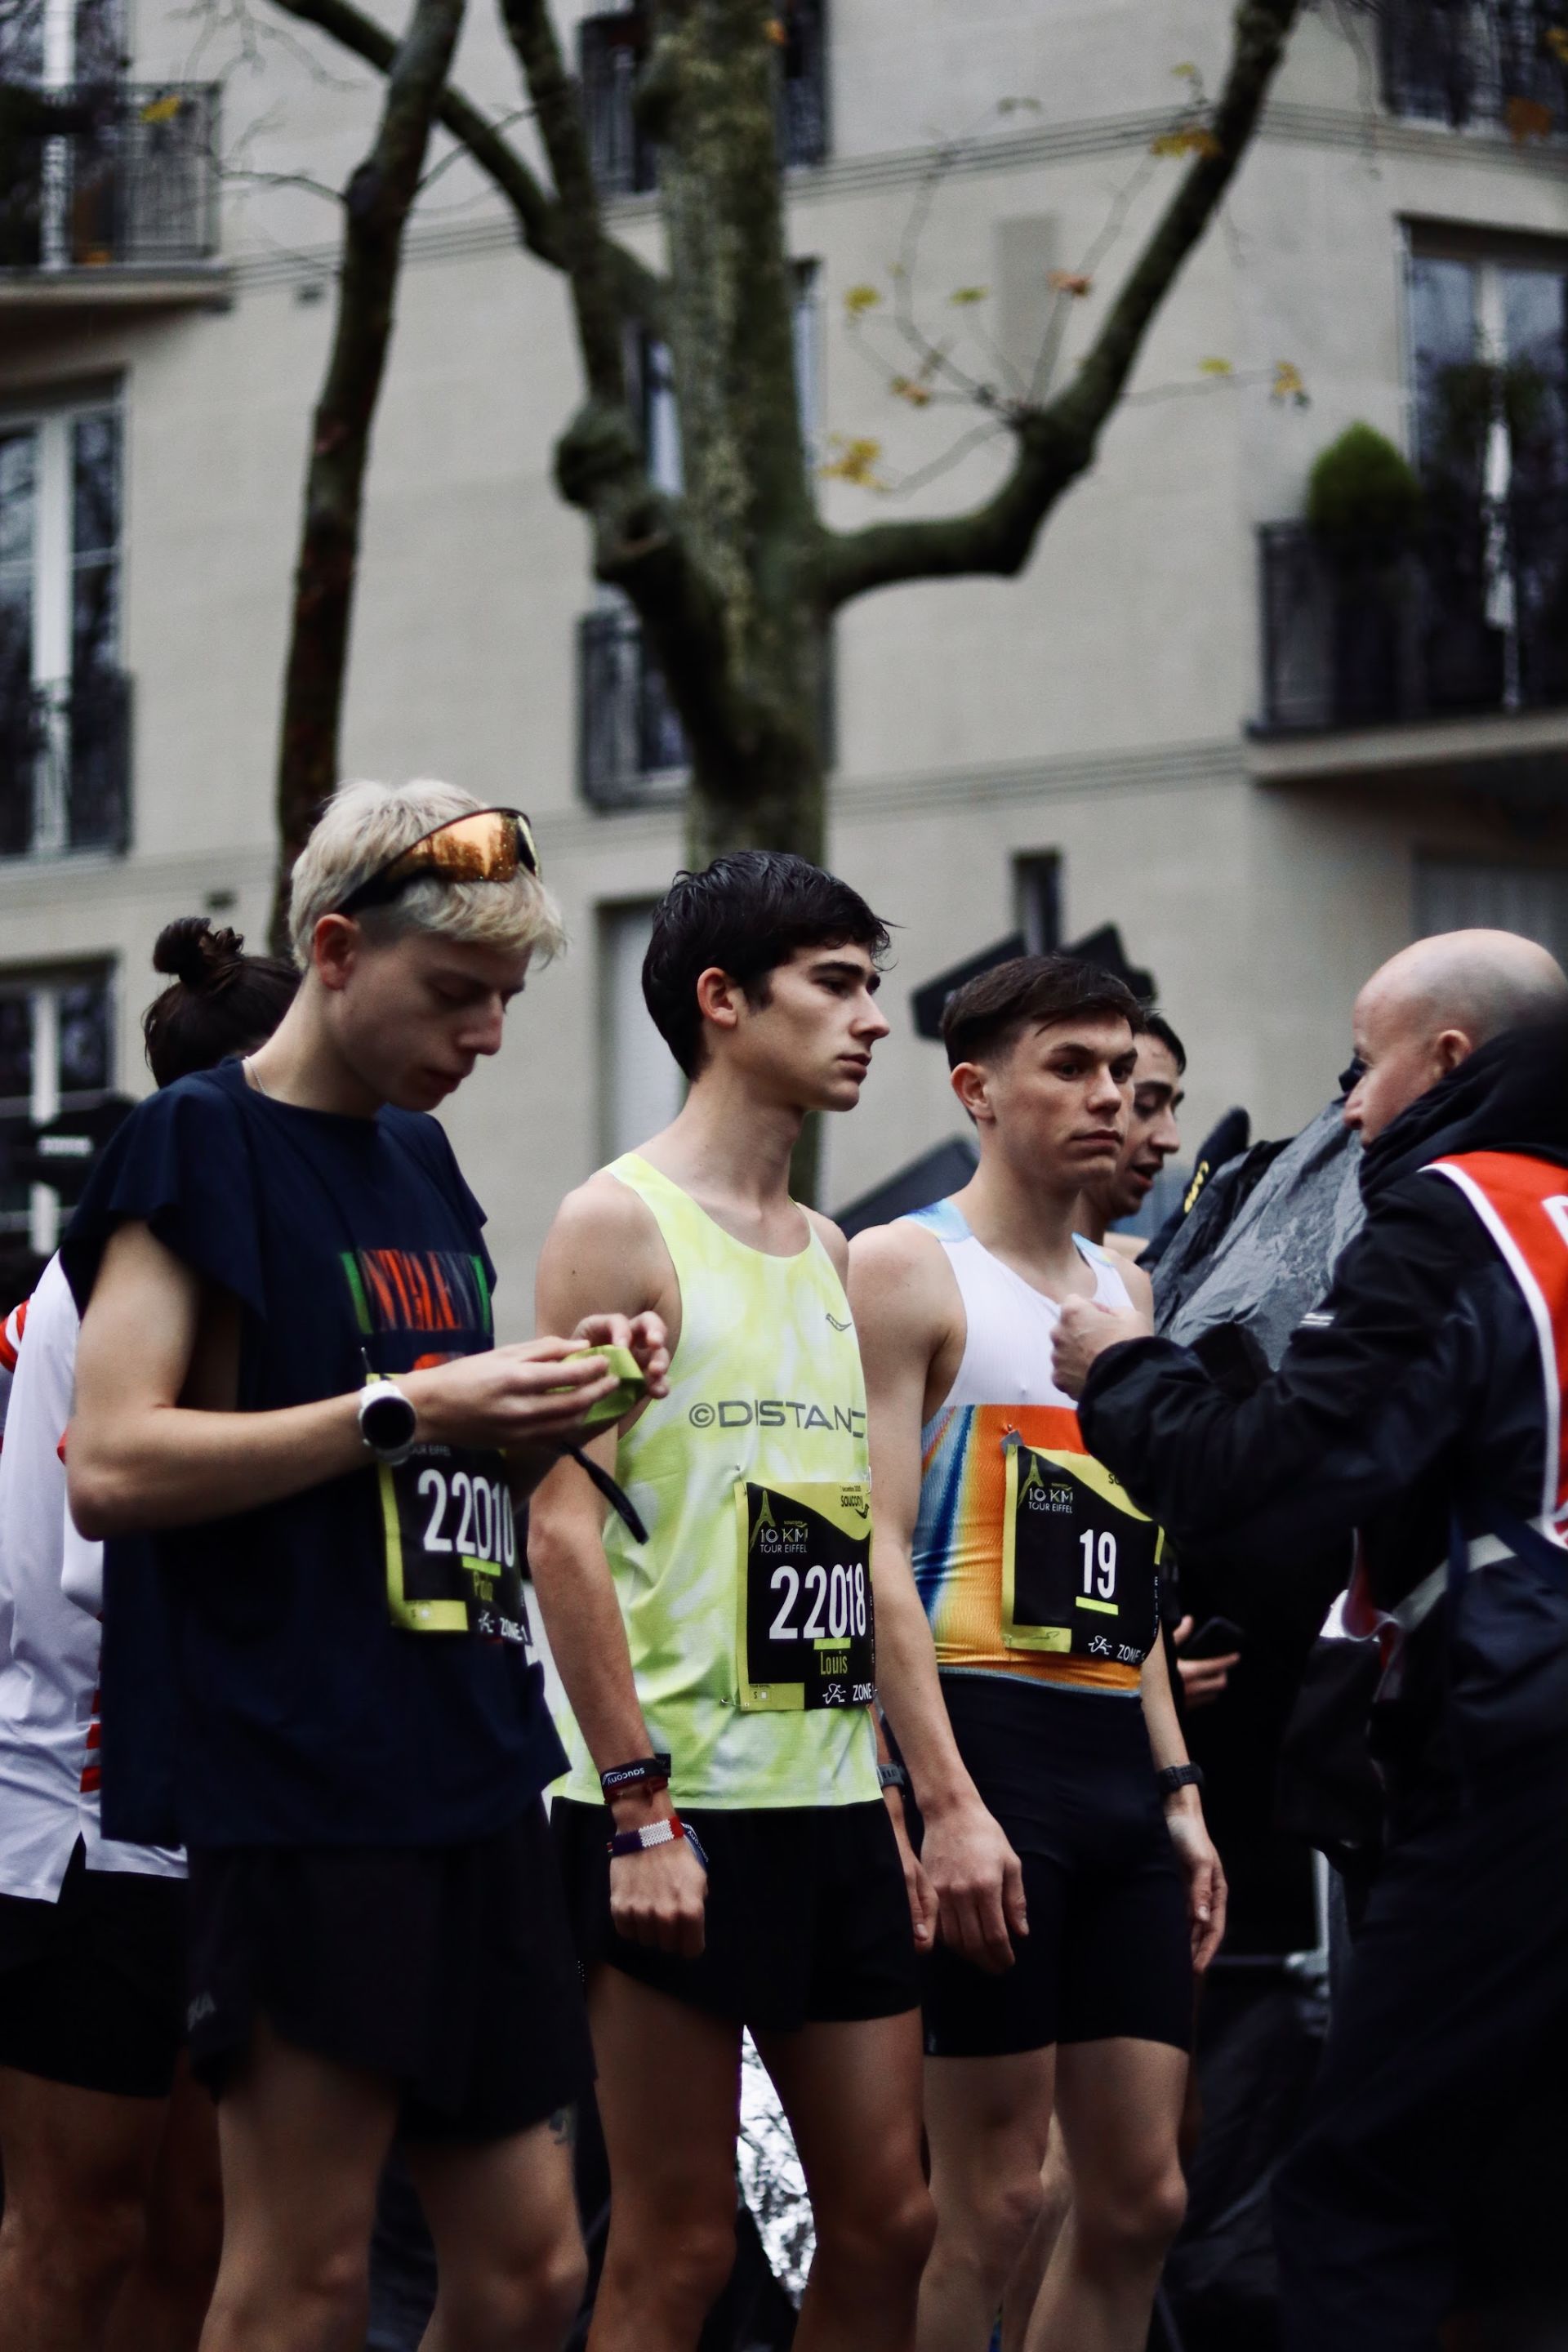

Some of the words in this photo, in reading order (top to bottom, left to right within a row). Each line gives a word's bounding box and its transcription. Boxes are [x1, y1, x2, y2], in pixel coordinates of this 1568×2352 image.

[1029, 1487, 1046, 1502] 10
[1050, 1489, 1073, 1503] KM
[417, 1468, 514, 1567] 22010
[1028, 1501, 1050, 1512] TOUR
[1052, 1503, 1073, 1514] EIFFEL
[760, 1528, 779, 1544] 10
[782, 1528, 808, 1543] KM
[760, 1544, 782, 1553] TOUR
[785, 1544, 808, 1553] EIFFEL
[1080, 1529, 1117, 1599] 19
[769, 1561, 866, 1640] 22018
[499, 1617, 523, 1641] ZONE
[820, 1650, 848, 1675] Louis
[852, 1682, 872, 1702] ZONE
[607, 1767, 645, 1786] saucony
